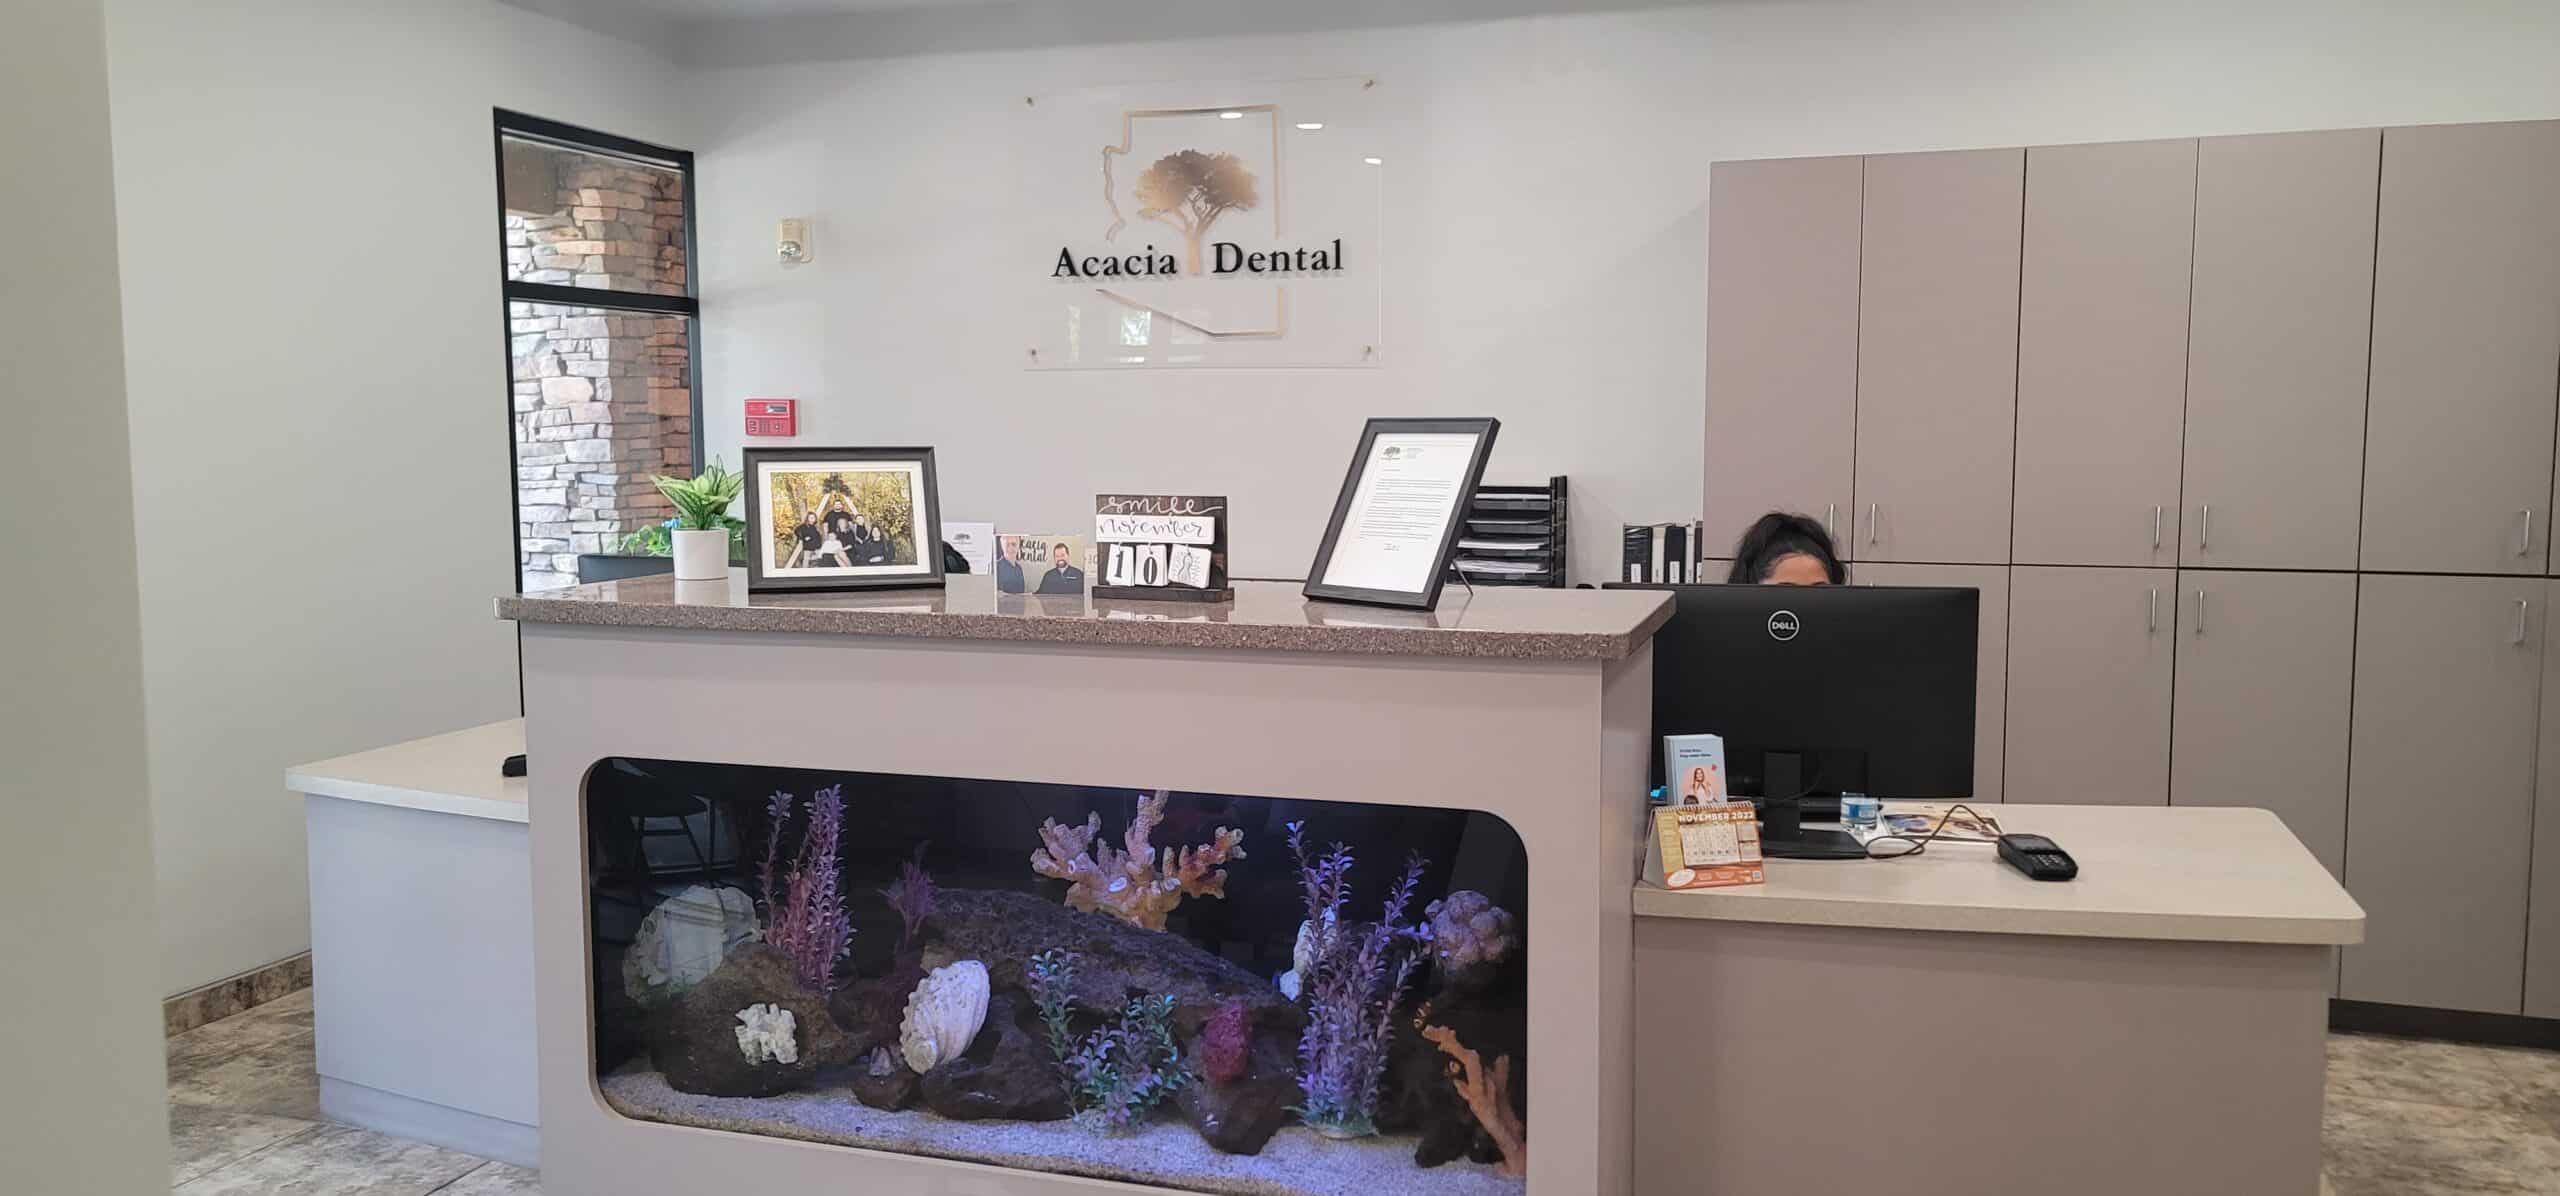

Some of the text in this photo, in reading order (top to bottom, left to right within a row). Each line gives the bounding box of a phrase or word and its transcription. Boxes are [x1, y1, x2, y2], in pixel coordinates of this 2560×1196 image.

[1051, 238, 1345, 278] Acacia Dental
[1098, 496, 1223, 515] smile
[1772, 621, 1796, 630] DELL
[1679, 812, 1729, 822] NOVEMBER
